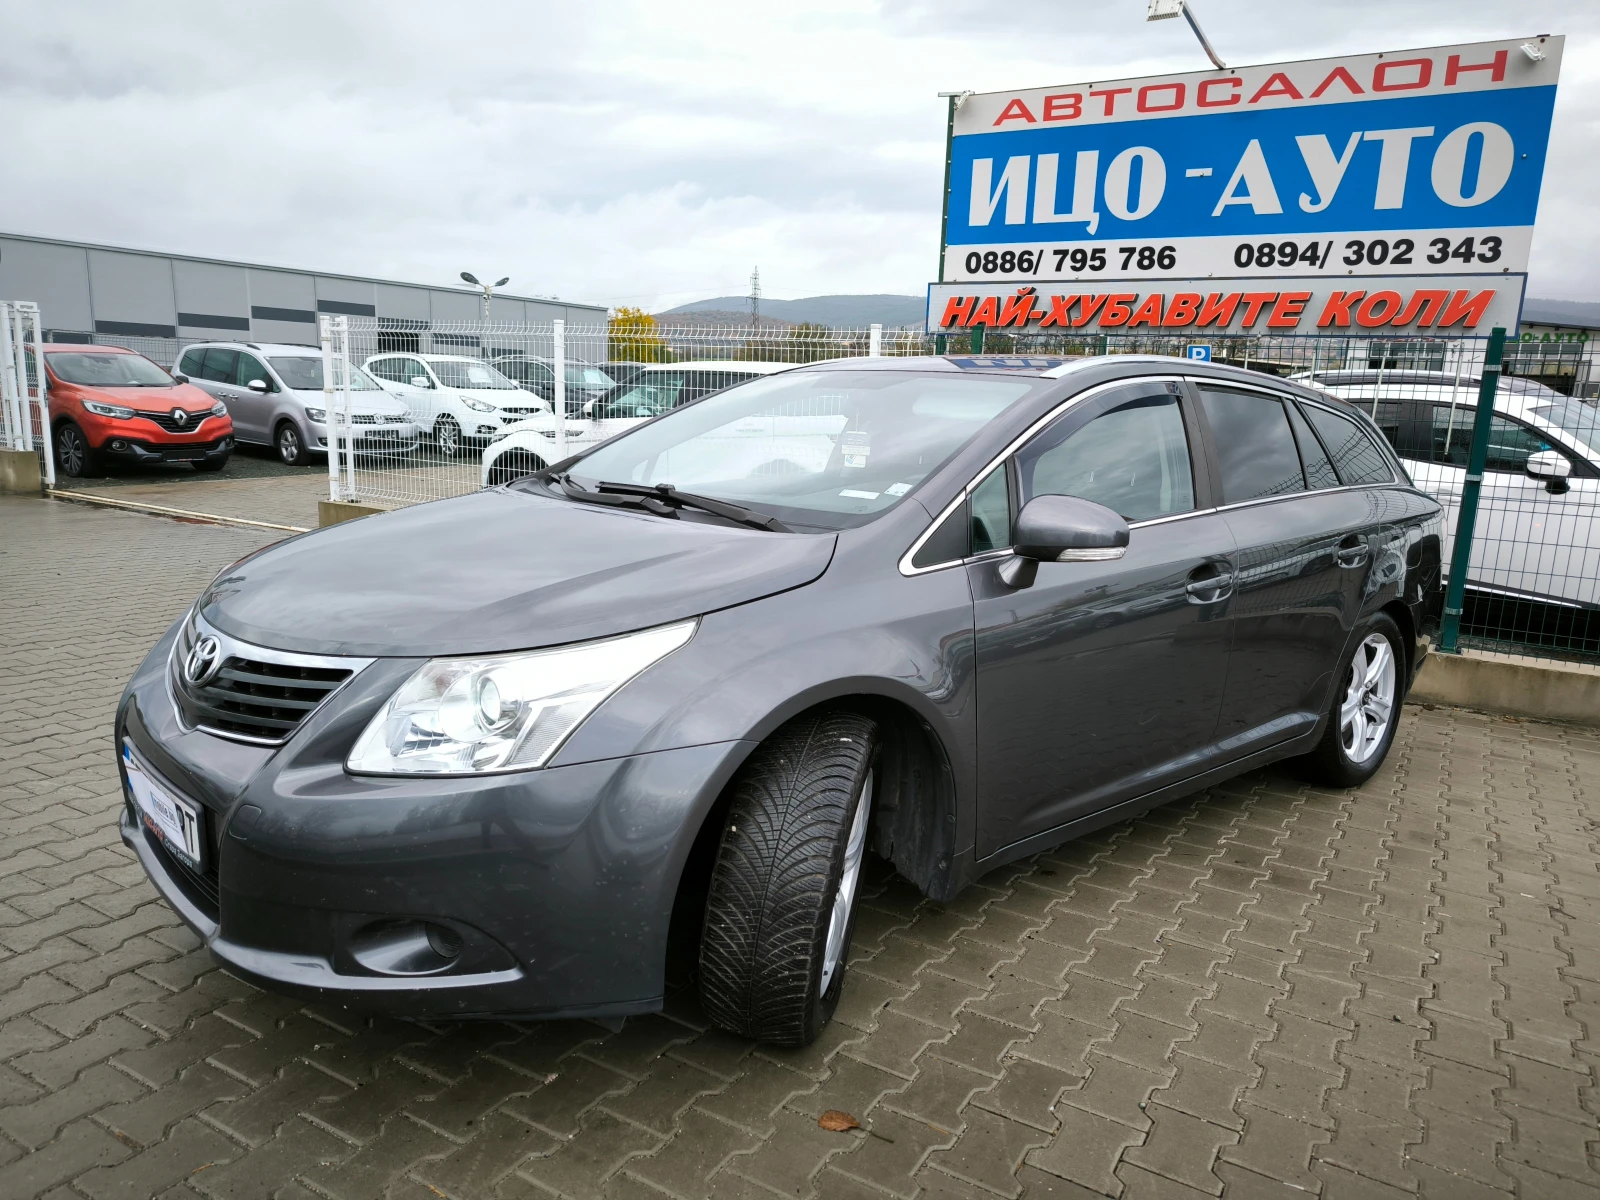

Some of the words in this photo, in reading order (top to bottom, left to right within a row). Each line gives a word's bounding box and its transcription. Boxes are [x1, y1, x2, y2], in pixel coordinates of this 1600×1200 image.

[992, 50, 1508, 127] АВТОСАЛОН
[965, 249, 1043, 275] 0886/
[1052, 248, 1107, 272] 795
[1118, 245, 1177, 271] 786
[1233, 240, 1334, 270] 0894/
[1342, 238, 1415, 266] 302
[1426, 236, 1503, 265] 343
[939, 286, 1313, 328] НАЙ-ХУБАВИТЕ
[1316, 289, 1497, 328] КОЛИ
[1192, 347, 1206, 360] P
